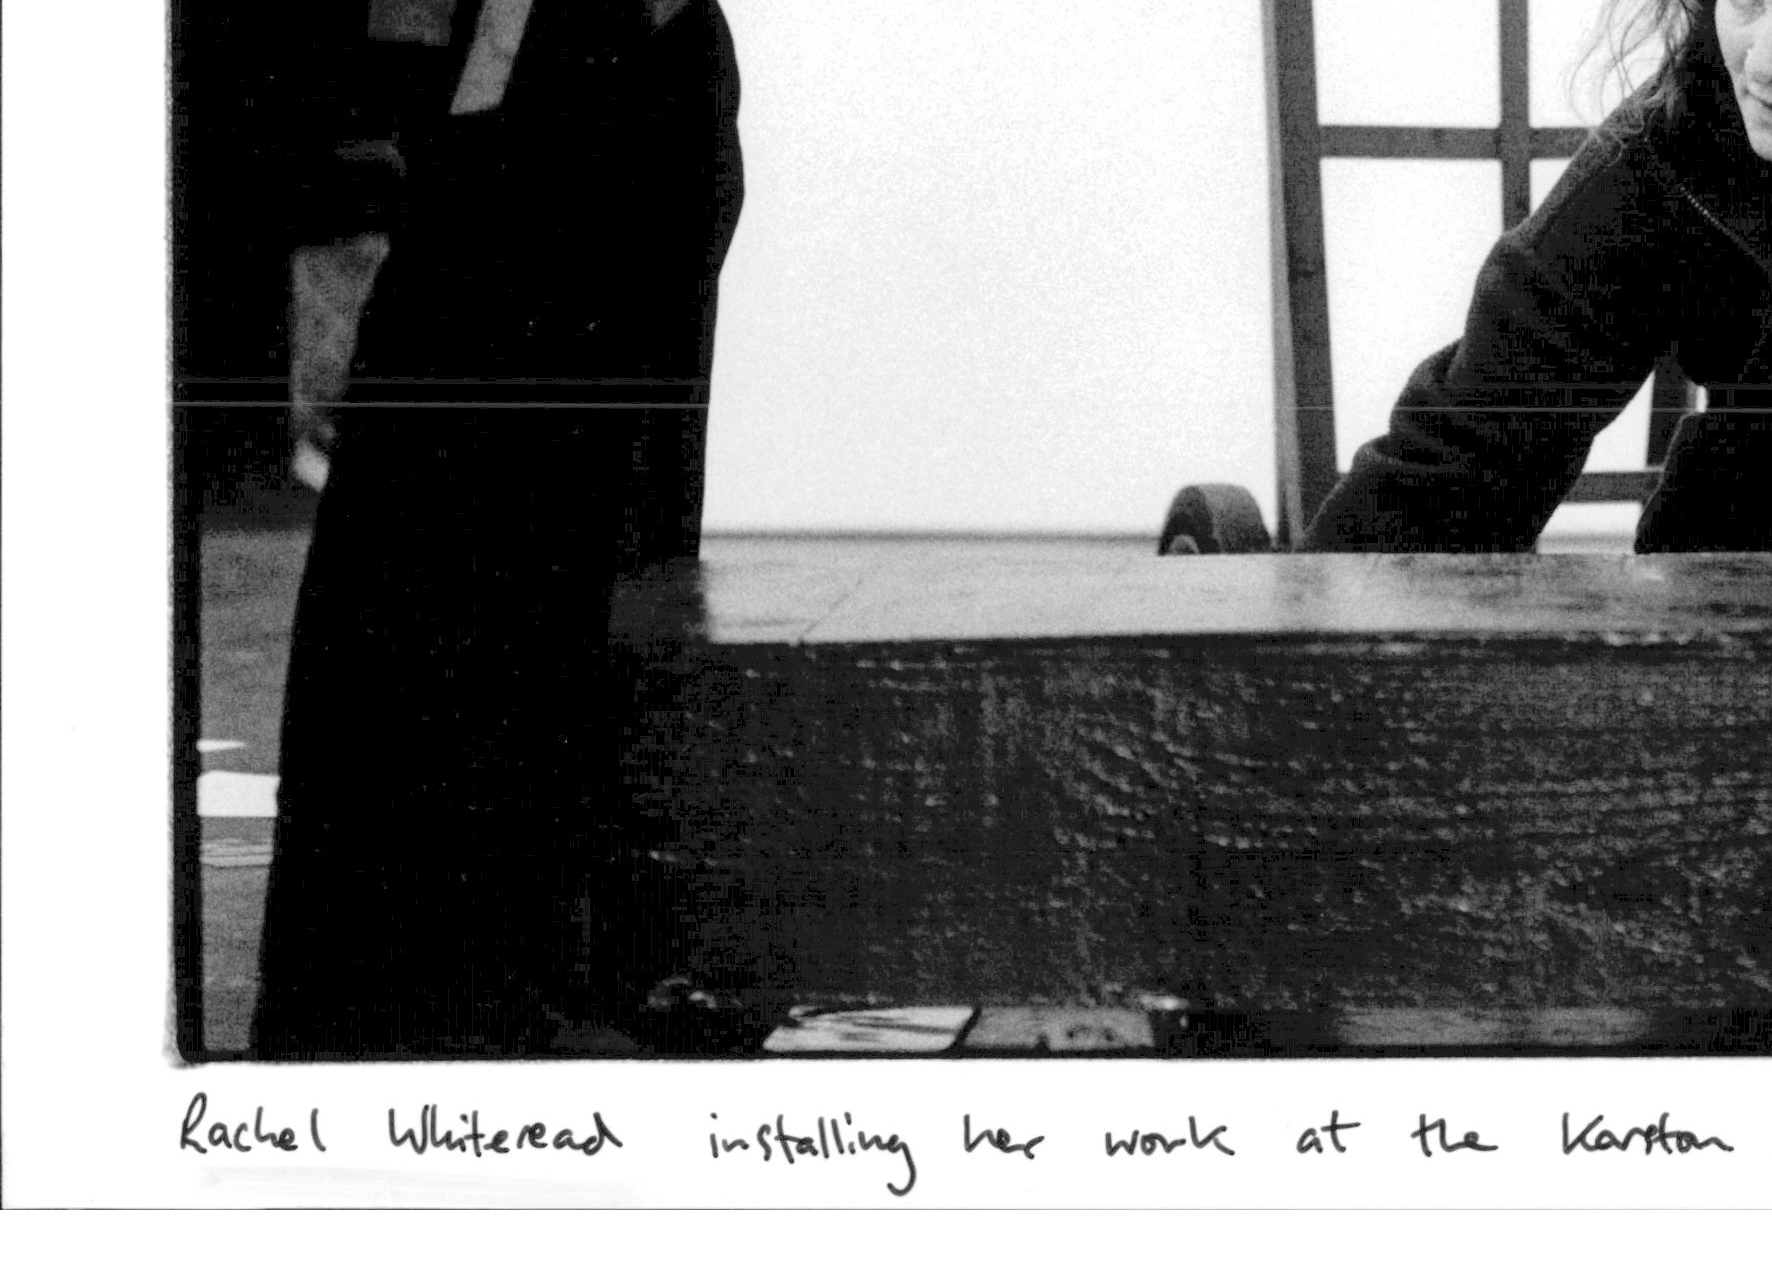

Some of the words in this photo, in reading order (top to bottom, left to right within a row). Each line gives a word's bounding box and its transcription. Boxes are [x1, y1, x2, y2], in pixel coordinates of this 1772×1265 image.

[180, 1091, 327, 1155] Rachel
[388, 1104, 624, 1158] Whiteread
[709, 1111, 917, 1197] installing
[963, 1114, 1045, 1160] her
[1105, 1115, 1236, 1157] work
[1296, 1109, 1361, 1154] at
[1410, 1113, 1499, 1158] the
